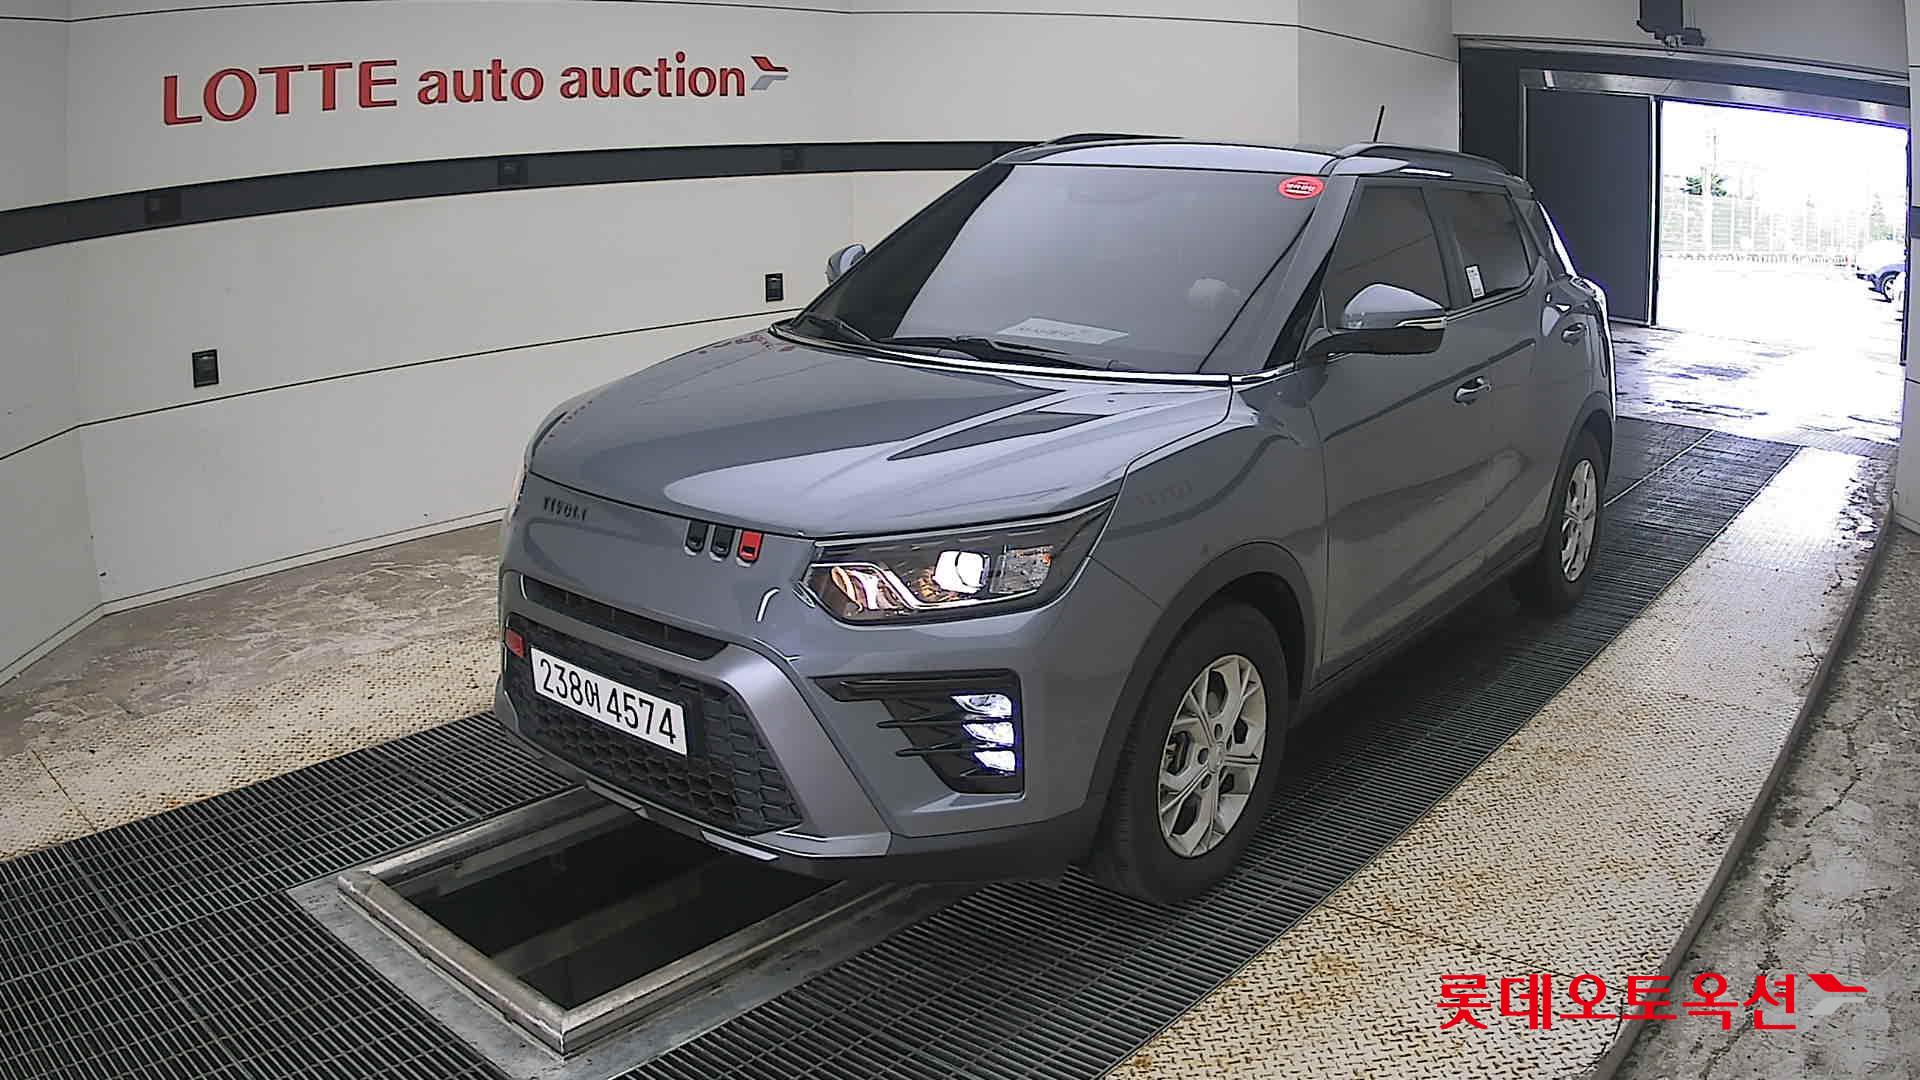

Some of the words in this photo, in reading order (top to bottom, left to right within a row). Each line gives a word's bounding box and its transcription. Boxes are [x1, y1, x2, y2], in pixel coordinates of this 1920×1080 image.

[162, 59, 398, 126] LOTTE
[416, 58, 545, 105] auto
[559, 51, 747, 99] auction
